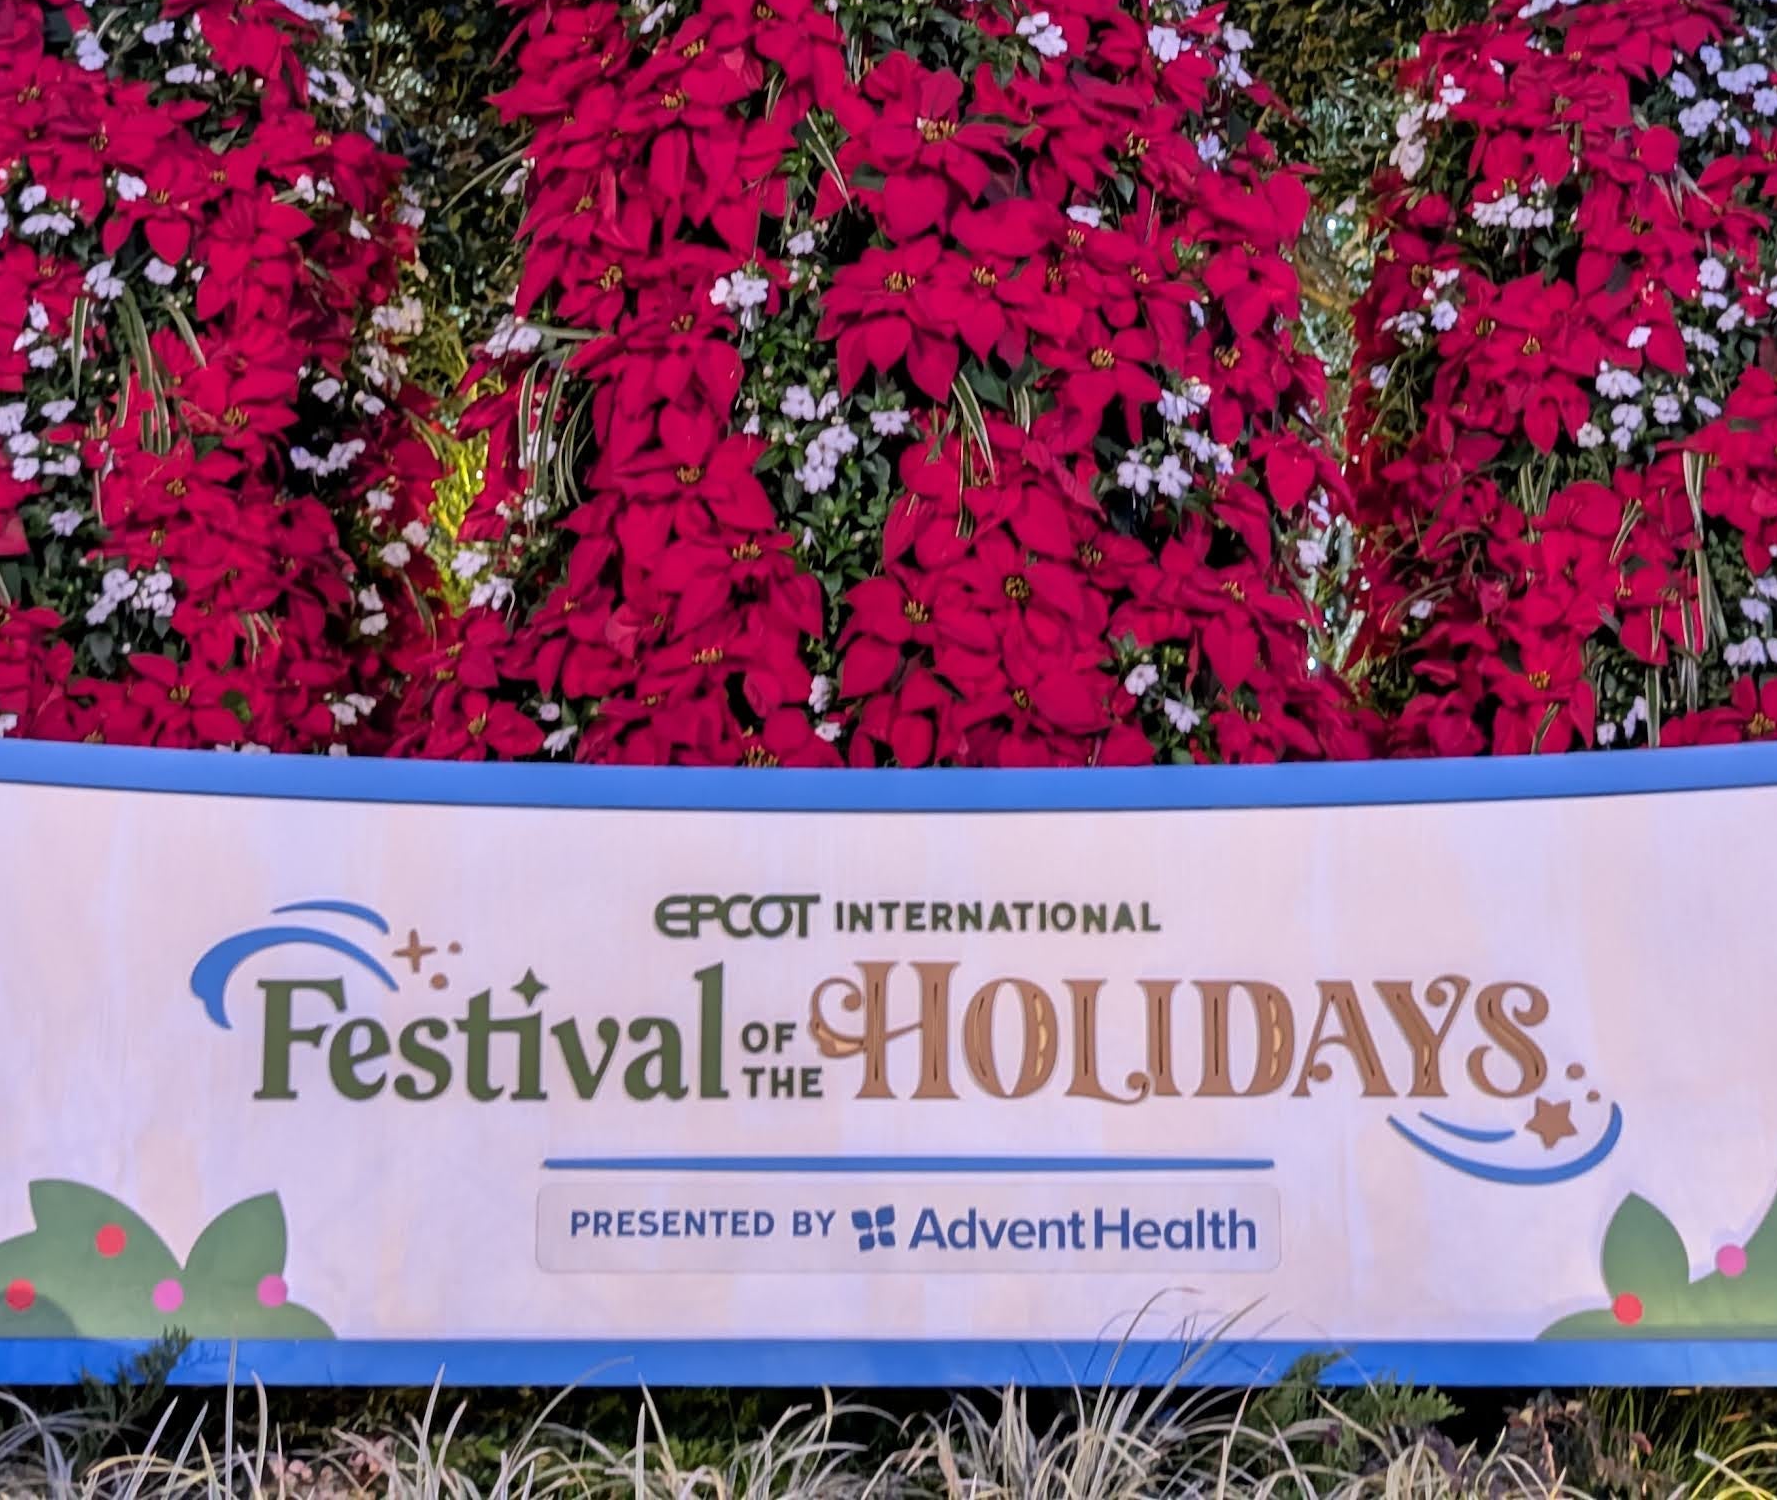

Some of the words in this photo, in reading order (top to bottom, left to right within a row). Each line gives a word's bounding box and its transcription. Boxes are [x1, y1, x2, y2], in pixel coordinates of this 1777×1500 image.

[654, 894, 821, 938] EPCOT
[833, 901, 1161, 933] INTERNATIONAL
[252, 961, 729, 1101] Festival
[741, 1022, 796, 1053] OF
[806, 960, 1550, 1105] HOLIDAYS
[741, 1067, 823, 1098] THE
[569, 1210, 775, 1238] PRESENTED
[793, 1210, 837, 1238] BY
